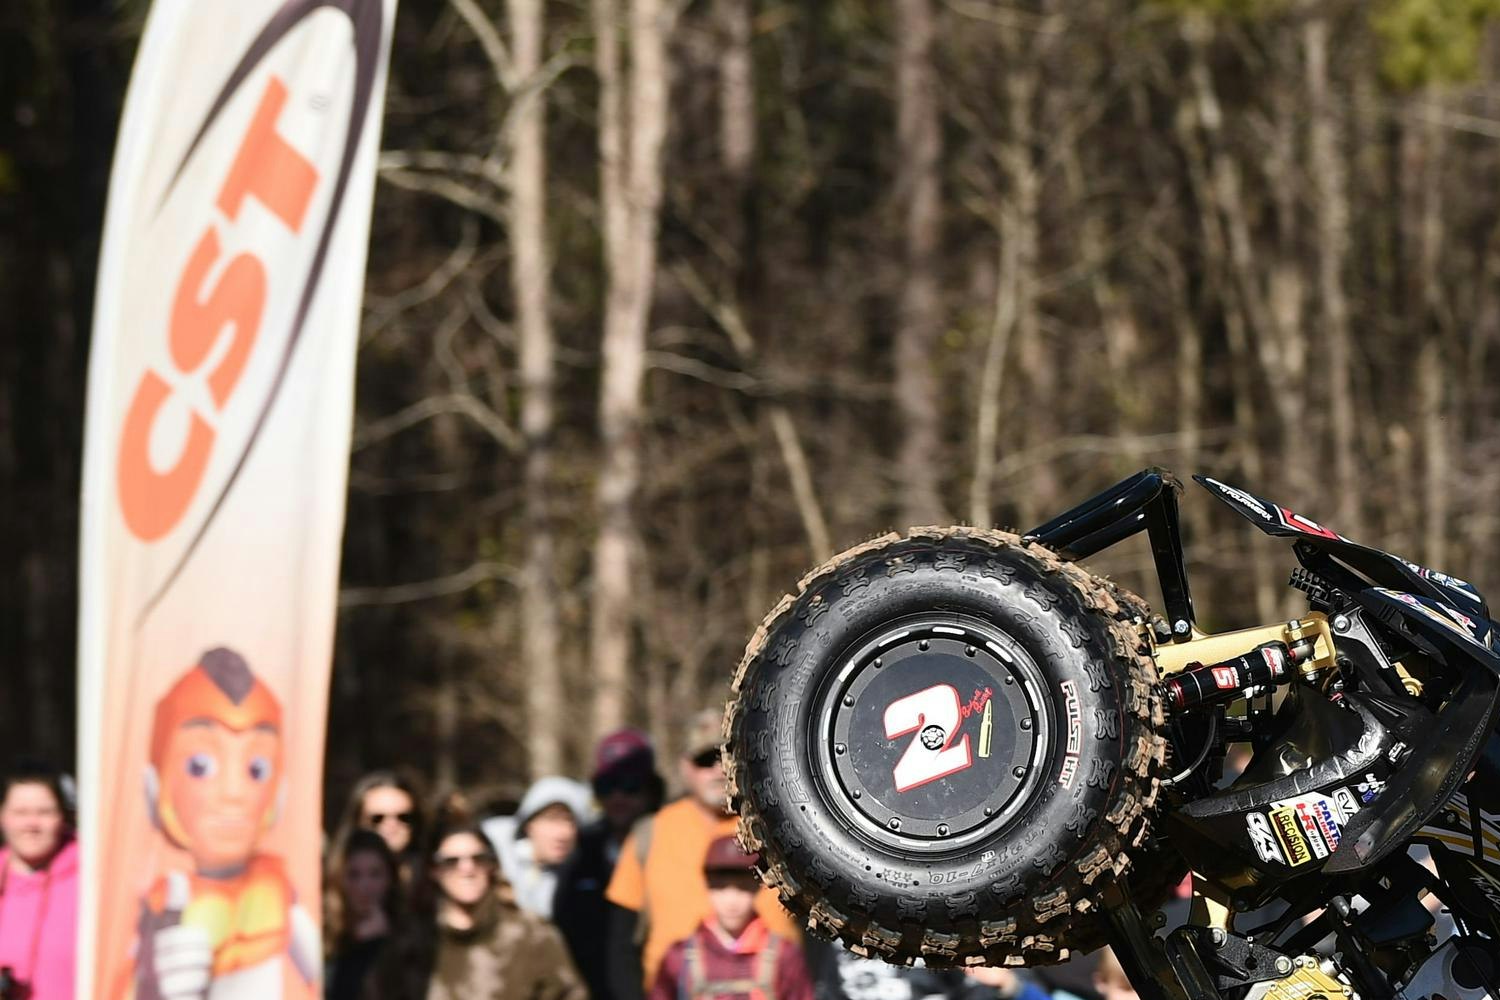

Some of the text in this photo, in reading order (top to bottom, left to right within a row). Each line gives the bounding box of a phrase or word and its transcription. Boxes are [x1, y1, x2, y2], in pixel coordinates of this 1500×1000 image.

[116, 74, 320, 544] CST
[883, 683, 973, 793] 2
[1058, 679, 1082, 790] PULSE HT
[1337, 791, 1355, 819] EVA
